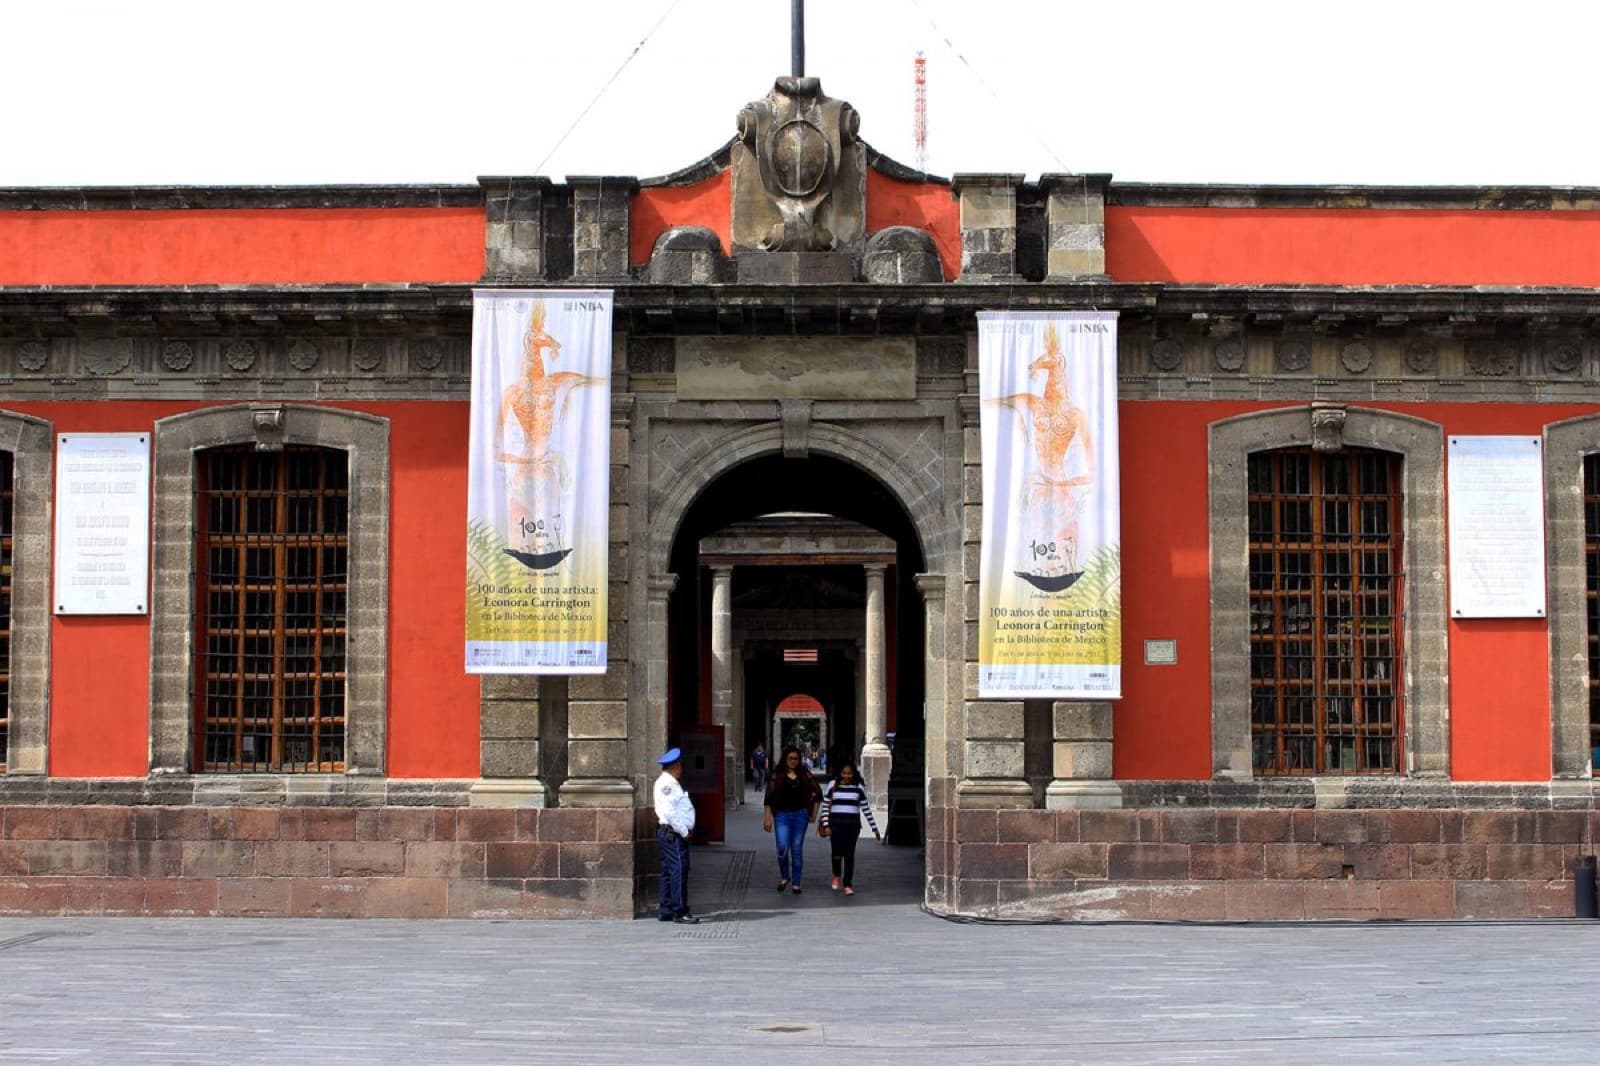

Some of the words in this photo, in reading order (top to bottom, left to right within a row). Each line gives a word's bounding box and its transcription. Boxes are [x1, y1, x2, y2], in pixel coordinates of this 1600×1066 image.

[575, 302, 604, 311] INBA
[1080, 323, 1108, 333] INBA
[477, 584, 495, 594] 100
[498, 585, 522, 594] años
[525, 584, 537, 594] de
[540, 586, 560, 594] una
[562, 585, 598, 594] artista:
[484, 597, 528, 607] Leonora
[531, 597, 591, 610] Carrington
[494, 612, 502, 621] la
[504, 612, 546, 621] Biblioteca
[548, 612, 559, 621] de
[561, 612, 593, 621] México
[990, 608, 1008, 617] 100
[1010, 608, 1035, 617] años
[1037, 607, 1049, 617] de
[1052, 609, 1073, 617] una
[996, 621, 1041, 630] Leonora
[1043, 620, 1104, 633] Carrington
[1007, 635, 1017, 644] la
[1017, 635, 1059, 644] Biblioteca
[1062, 635, 1073, 644] de
[1075, 635, 1106, 644] México
